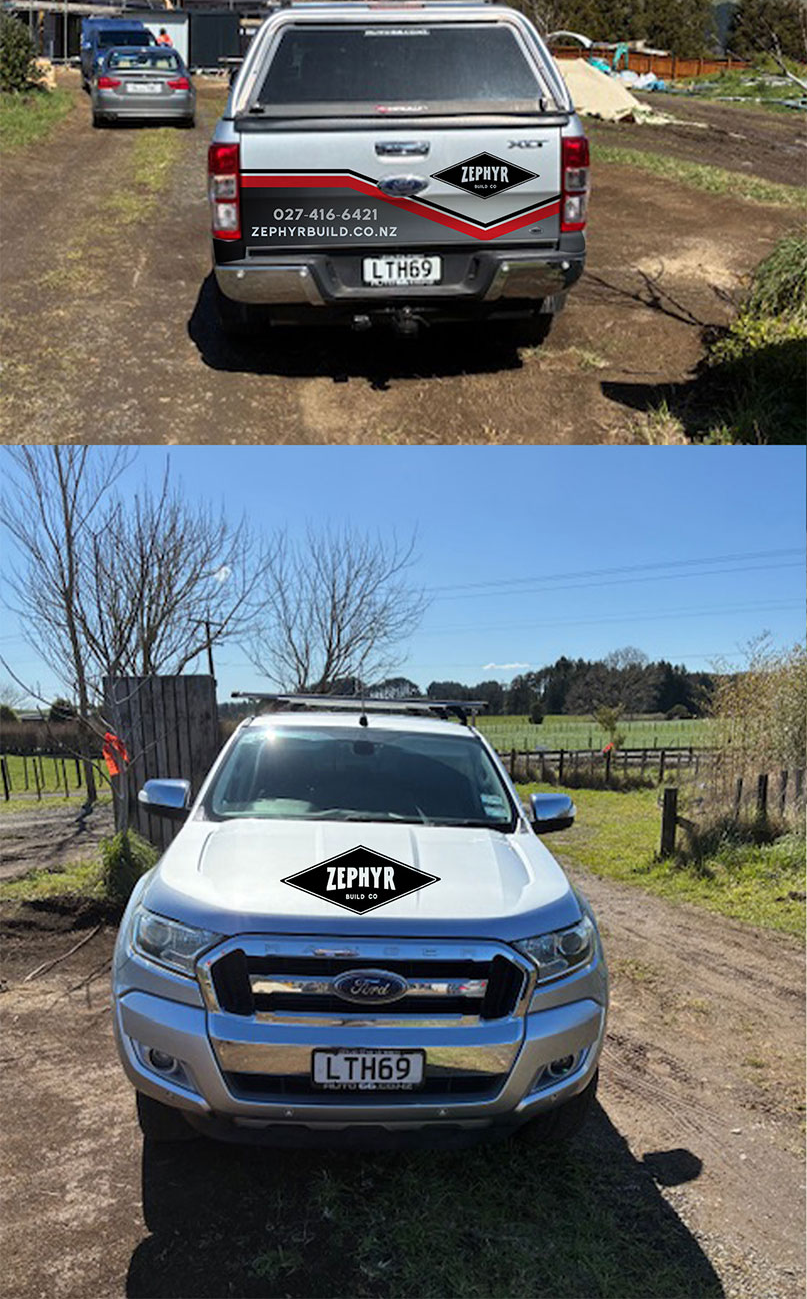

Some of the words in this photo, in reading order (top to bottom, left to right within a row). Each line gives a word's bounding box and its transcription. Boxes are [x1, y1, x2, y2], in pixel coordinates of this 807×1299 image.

[461, 165, 509, 183] ZEPHYR
[273, 208, 378, 221] 027-416-6421
[251, 226, 398, 237] ZEPHYRBUILD.CO.NZ
[372, 260, 432, 279] LTH69
[326, 866, 396, 891] ZEPHYR
[350, 979, 391, 996] Ford
[326, 1056, 410, 1080] LTH69
